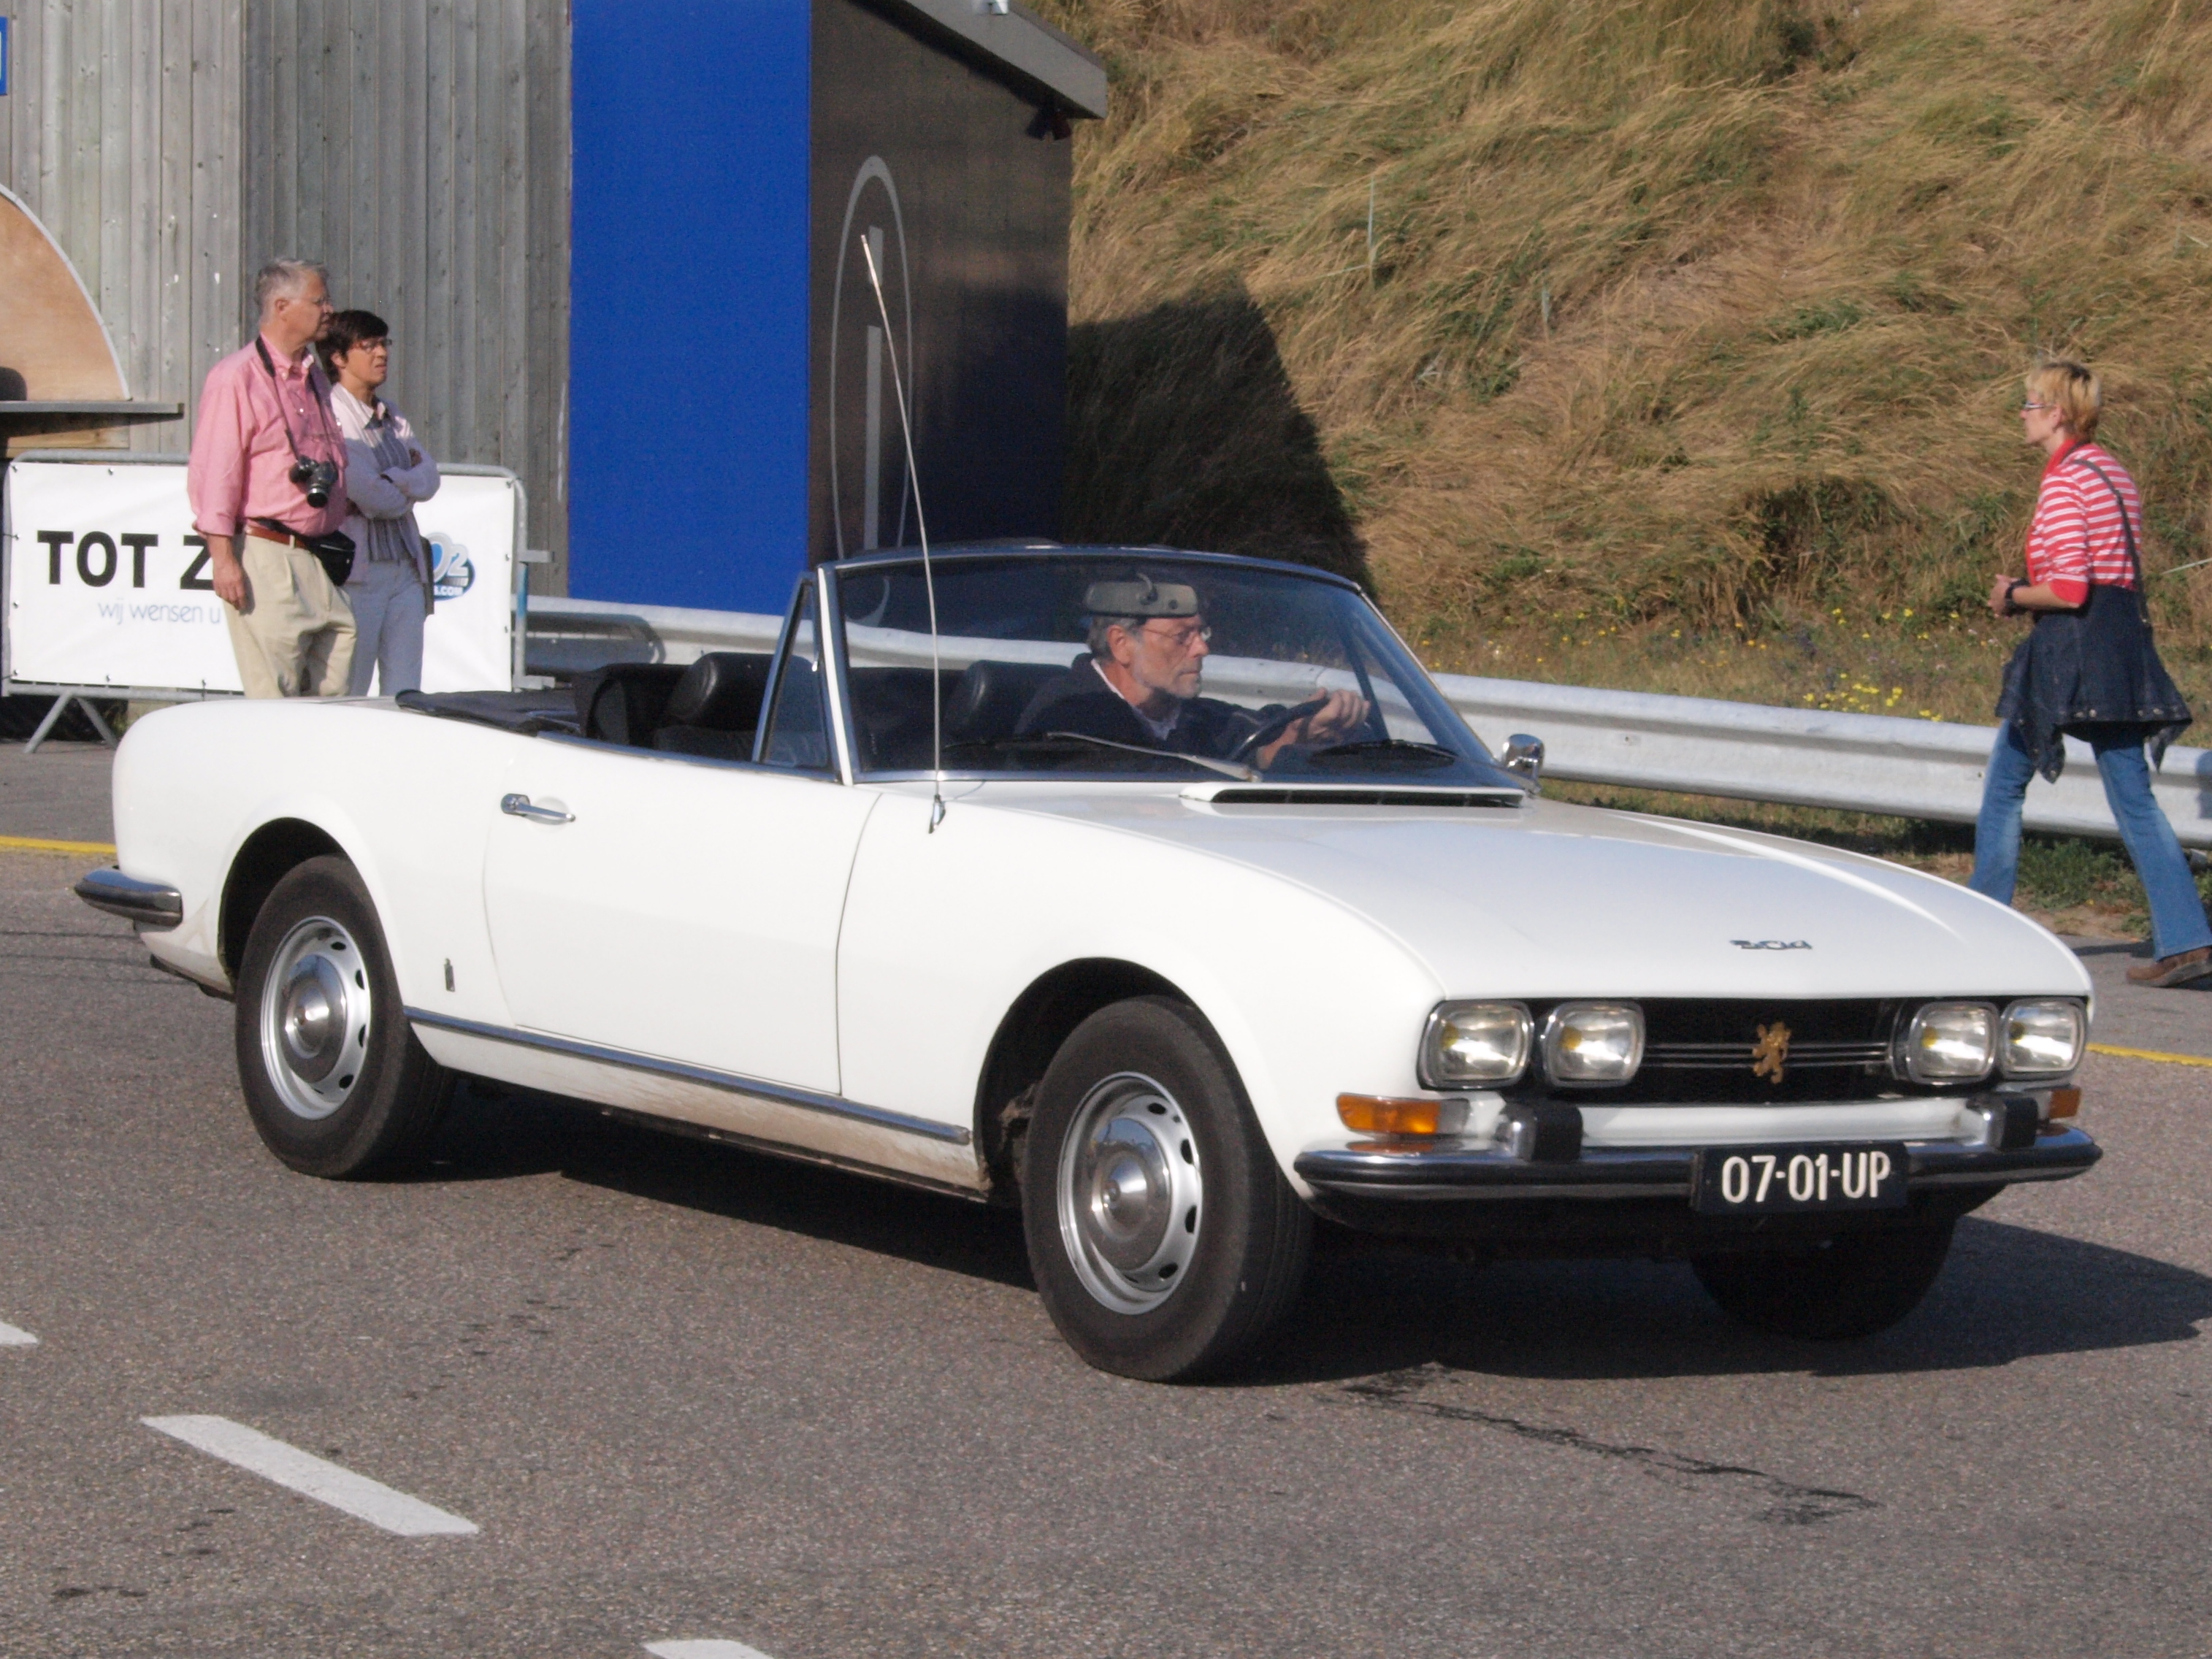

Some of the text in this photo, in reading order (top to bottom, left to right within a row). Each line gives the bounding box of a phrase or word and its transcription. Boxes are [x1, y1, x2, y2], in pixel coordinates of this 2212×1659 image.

[37, 530, 159, 589] TOT
[98, 598, 221, 626] wij wensen u
[1721, 1151, 1892, 1205] 07-01-UP
